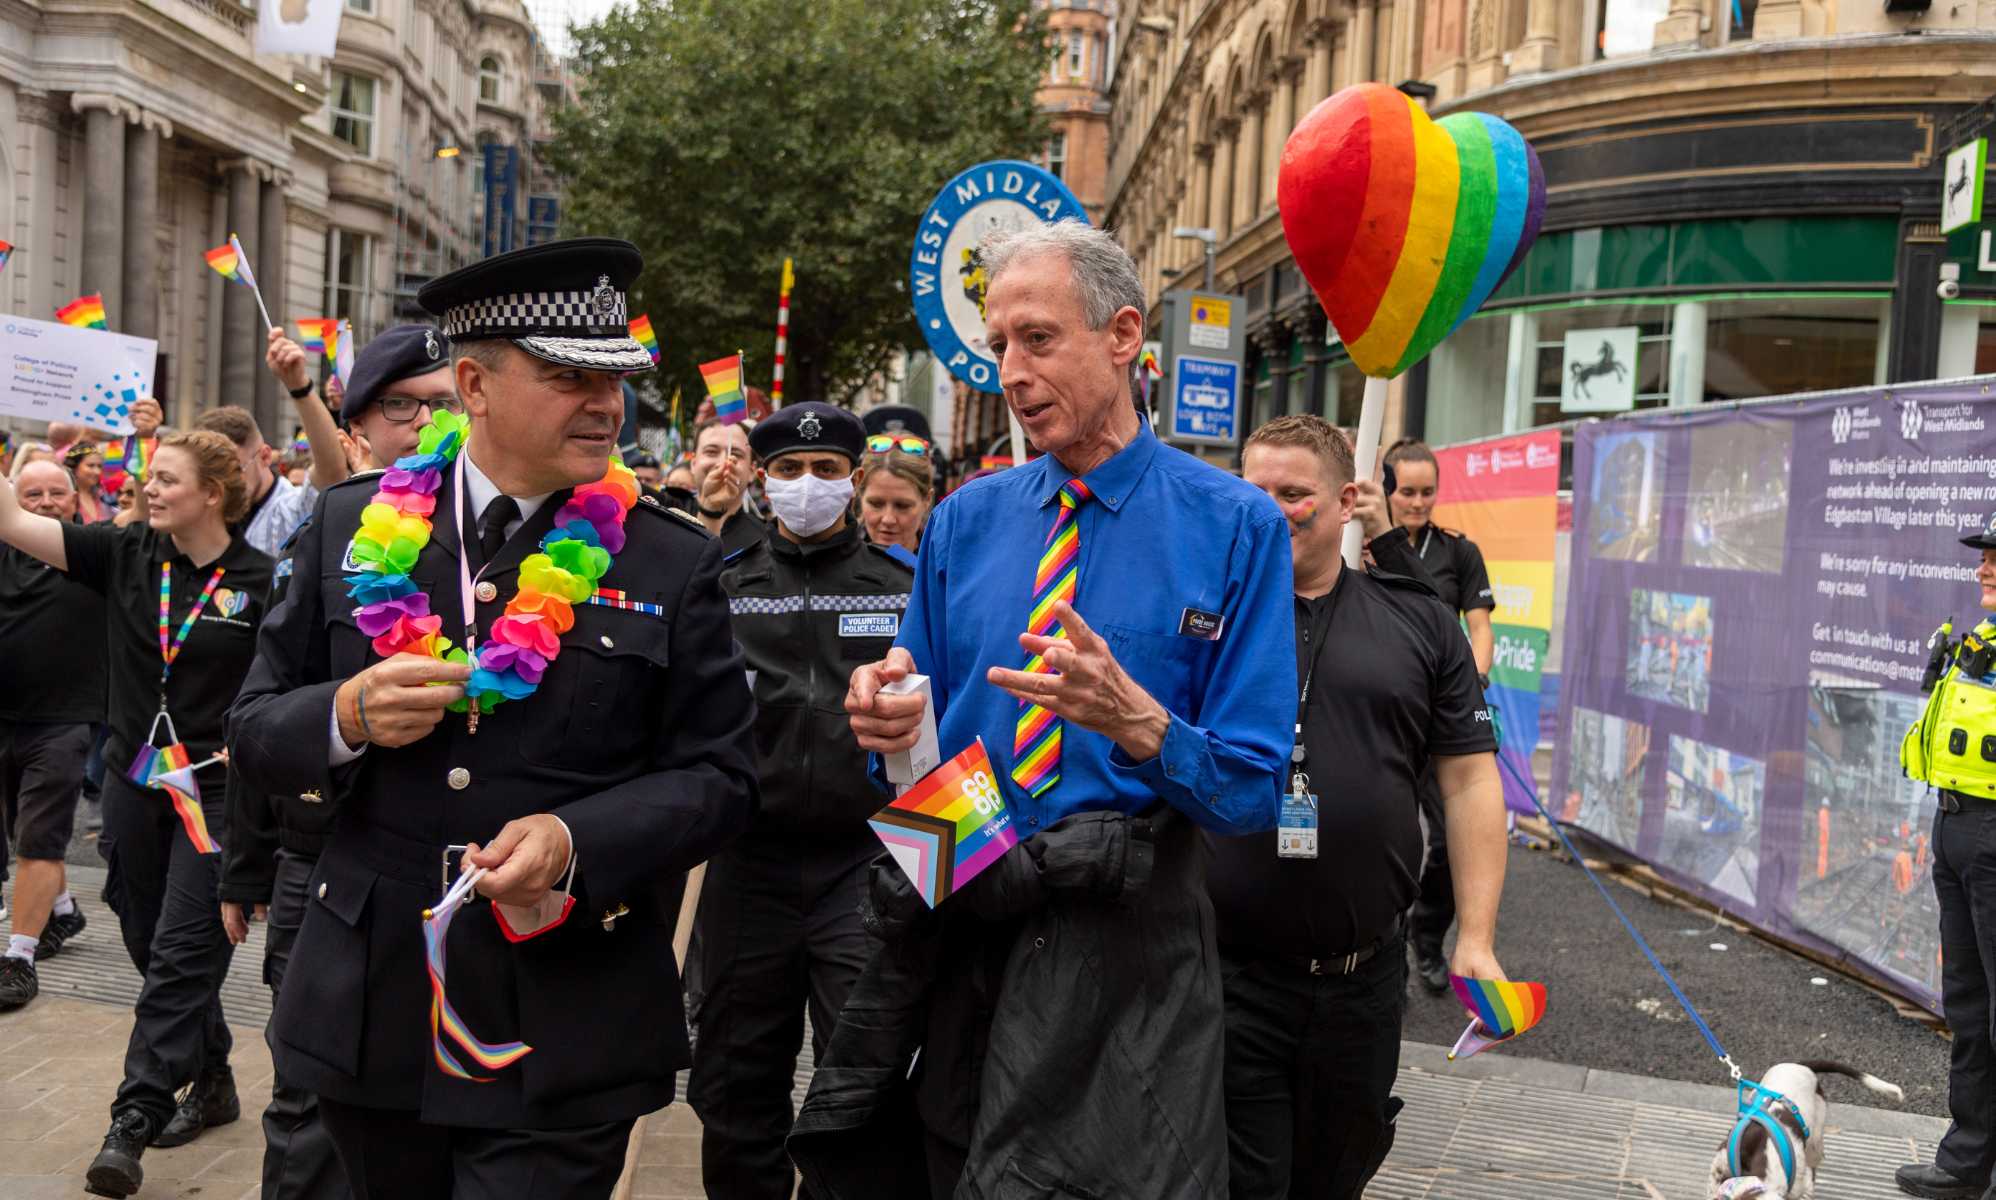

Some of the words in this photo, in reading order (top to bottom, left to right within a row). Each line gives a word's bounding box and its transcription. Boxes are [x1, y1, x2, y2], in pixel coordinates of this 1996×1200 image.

[914, 209, 949, 296] WEST
[955, 171, 1062, 219] MIDLA
[948, 352, 990, 384] PO
[1923, 405, 1961, 419] Transport
[1961, 403, 1973, 416] for
[1923, 421, 1944, 432] West
[1944, 417, 1985, 431] Midlands
[1897, 455, 1907, 474] in
[1907, 455, 1930, 474] and
[1931, 454, 1996, 479] maintaining
[1826, 481, 1862, 499] network
[1863, 481, 1893, 499] ahead
[1894, 480, 1905, 499] of
[1906, 482, 1949, 506] opening
[1950, 486, 1958, 500] a
[1959, 485, 1983, 500] new
[1984, 486, 1996, 500] ro
[1825, 505, 1873, 528] Edgbaston
[1874, 505, 1907, 531] Village
[1908, 507, 1933, 527] later
[1935, 508, 1956, 527] this
[1958, 512, 1985, 532] year.
[1820, 552, 1845, 571] We're
[1845, 558, 1871, 577] sorry
[1872, 555, 1888, 574] for
[1888, 560, 1908, 581] any
[1908, 558, 1980, 582] inconvenienc
[1817, 579, 1835, 598] may
[1836, 581, 1868, 597] cause.
[847, 617, 890, 625] VOLUNTEER
[870, 624, 895, 632] CADET
[1812, 622, 1831, 641] Get
[1833, 625, 1844, 641] in
[1844, 628, 1871, 647] touch
[1871, 631, 1893, 650] with
[1893, 637, 1906, 652] us
[1907, 638, 1920, 656] at
[1810, 650, 1925, 682] communications@metr
[1474, 710, 1491, 722] POL
